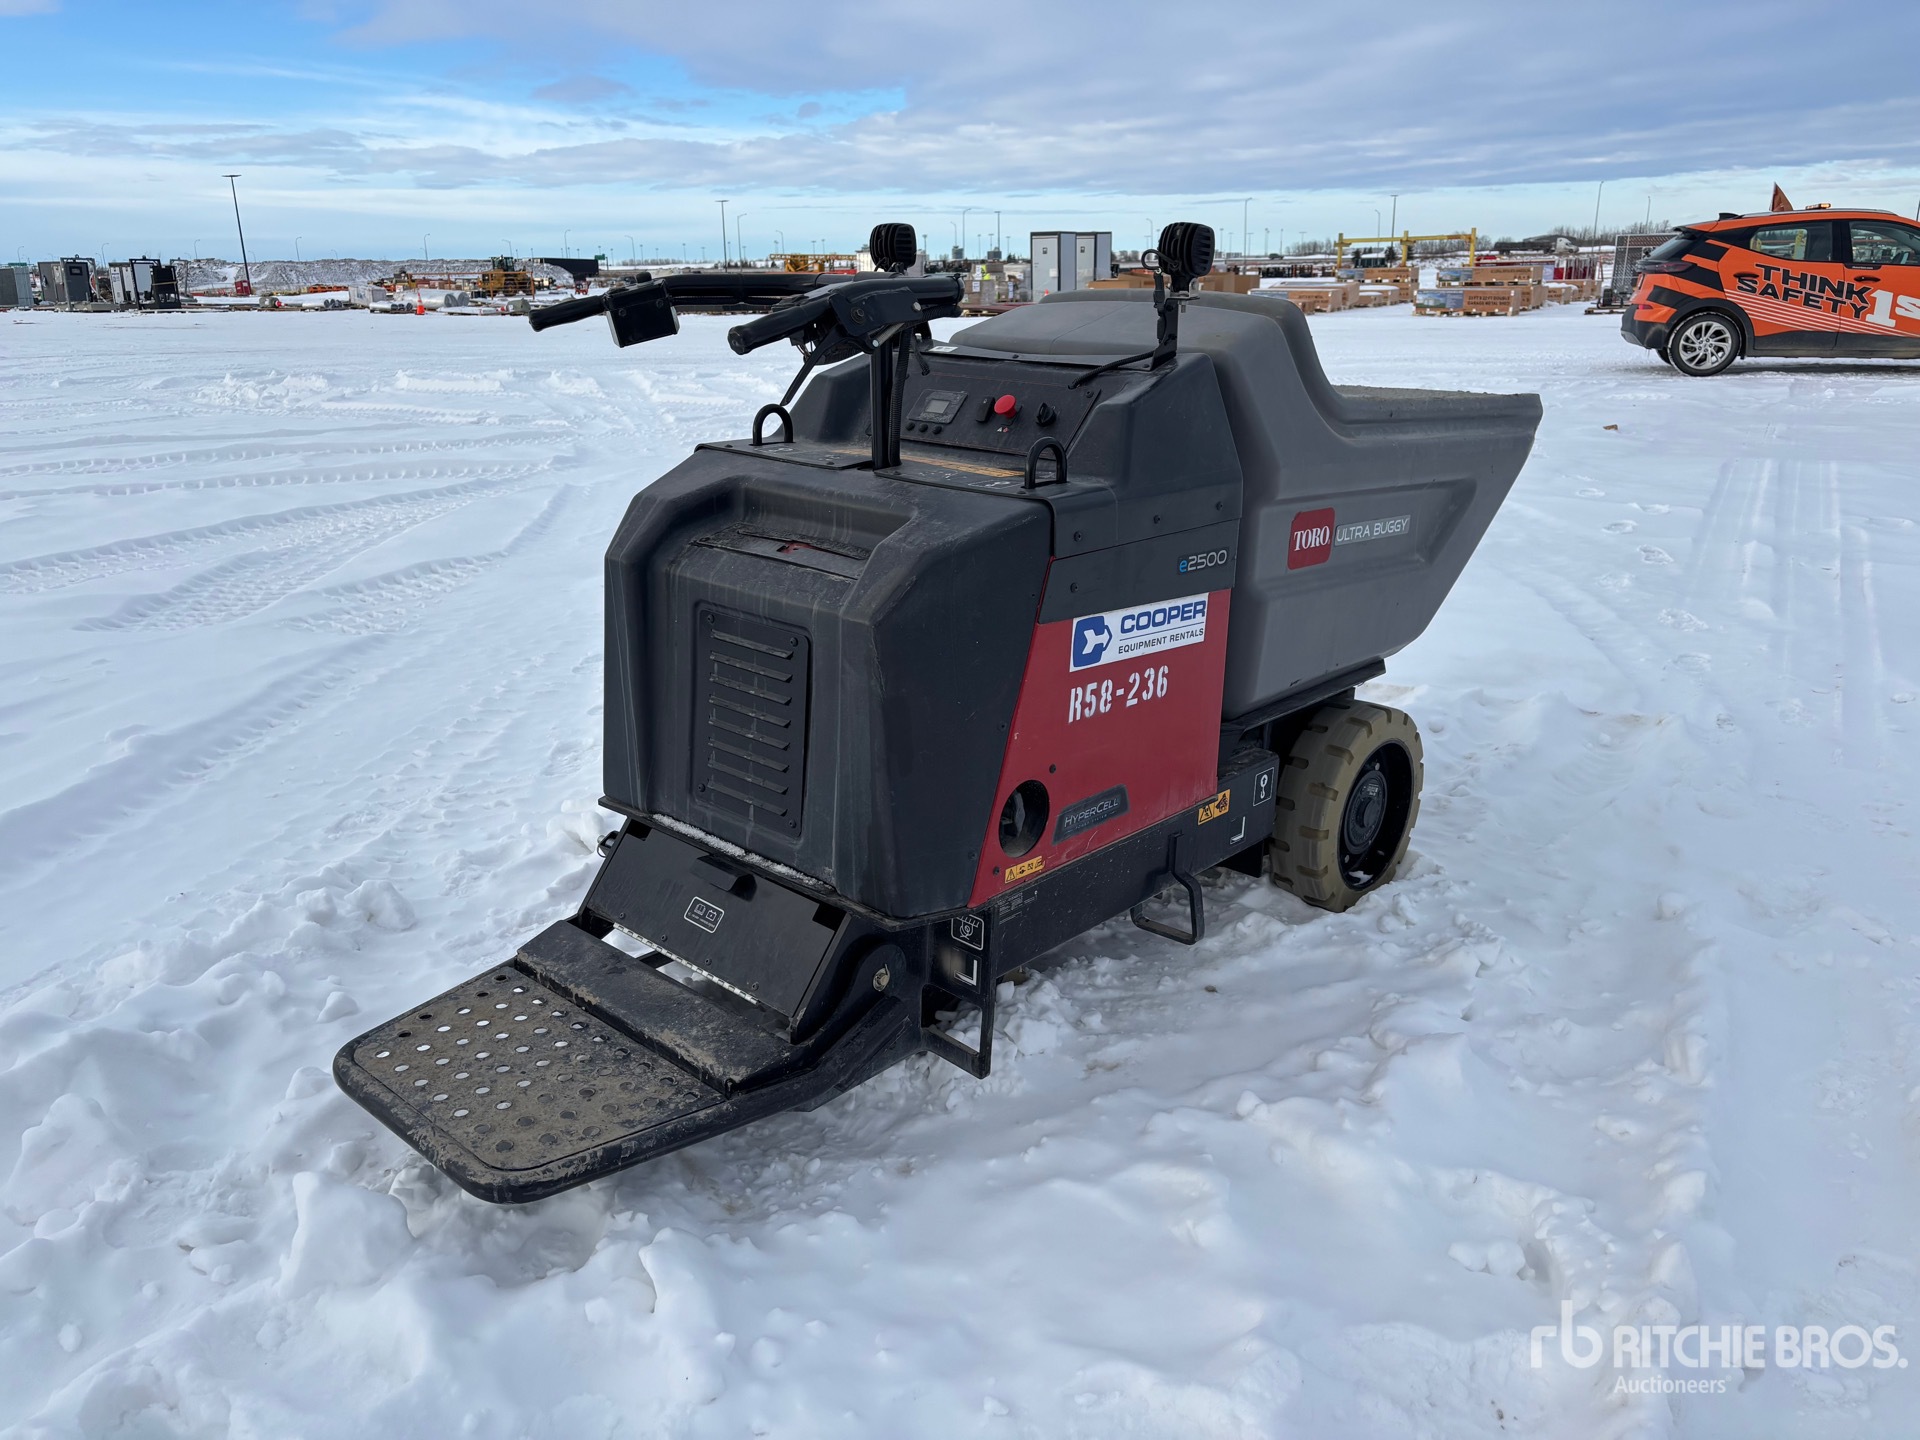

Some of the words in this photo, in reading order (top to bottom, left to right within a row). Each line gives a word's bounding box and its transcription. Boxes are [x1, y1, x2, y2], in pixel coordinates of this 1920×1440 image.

[1737, 277, 1869, 319] SAFETY
[1755, 263, 1872, 306] THINK
[1294, 525, 1330, 551] TORO
[1337, 525, 1370, 541] ULTRA
[1373, 518, 1408, 535] BUGGY
[1179, 549, 1227, 572] e2500
[1120, 600, 1206, 634] COOPER
[1118, 636, 1167, 654] EQUIPMENT
[1170, 628, 1204, 643] RENTALS
[1068, 665, 1169, 723] R58-236
